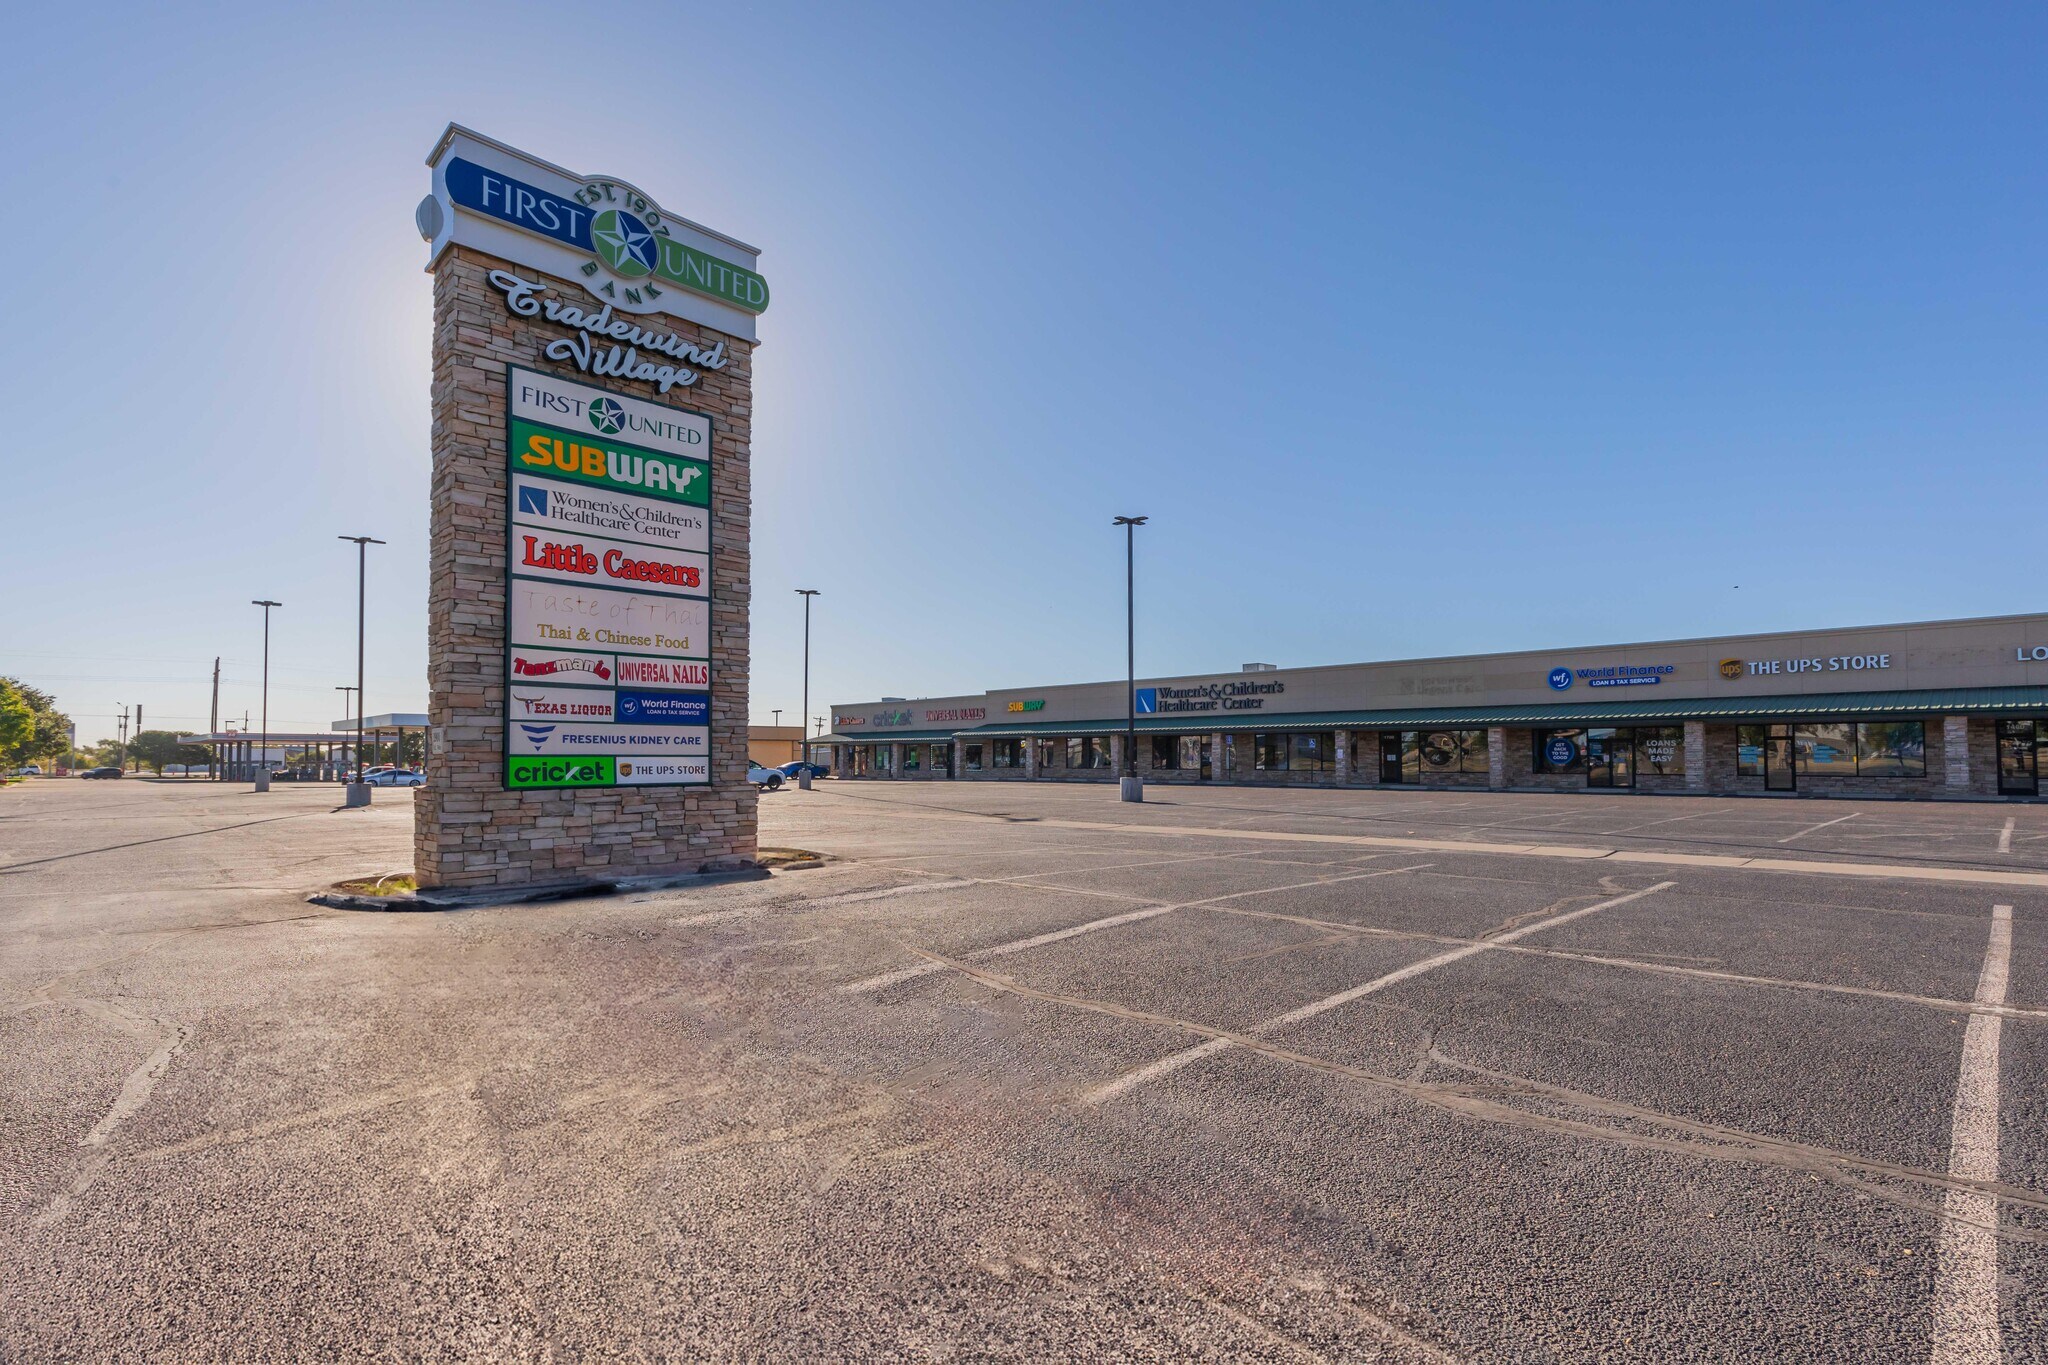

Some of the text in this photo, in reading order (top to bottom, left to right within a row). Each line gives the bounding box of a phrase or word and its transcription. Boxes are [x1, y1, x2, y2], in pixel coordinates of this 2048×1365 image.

[482, 175, 586, 239] FIRST
[581, 261, 663, 304] BANK
[665, 245, 766, 305] UNITED
[485, 269, 728, 370] Tradewind
[544, 331, 698, 393] Village
[522, 386, 702, 444] FIRST UNITED
[521, 435, 702, 494] SUBWAY
[552, 506, 681, 539] Healthcare Center
[523, 536, 700, 587] Little Caesars
[523, 591, 703, 625] Taste of Thai
[537, 624, 689, 649] Thai & Chinese Food
[618, 662, 708, 685] UNIVERSAL NAILS
[1576, 665, 1674, 678] World Finance
[1721, 664, 1741, 678] ups
[1748, 654, 1890, 675] THE UPS STORE
[1553, 672, 1567, 683] wf
[571, 704, 612, 716] LIQUOR
[641, 699, 706, 710] World Finance
[1008, 699, 1045, 712] SUBWAY
[1158, 697, 1264, 712] Healthcare Center
[562, 735, 701, 745] FRESENIUS KIDNEY CARE
[514, 762, 604, 781] cricket
[636, 766, 705, 775] THE UPS STORE
